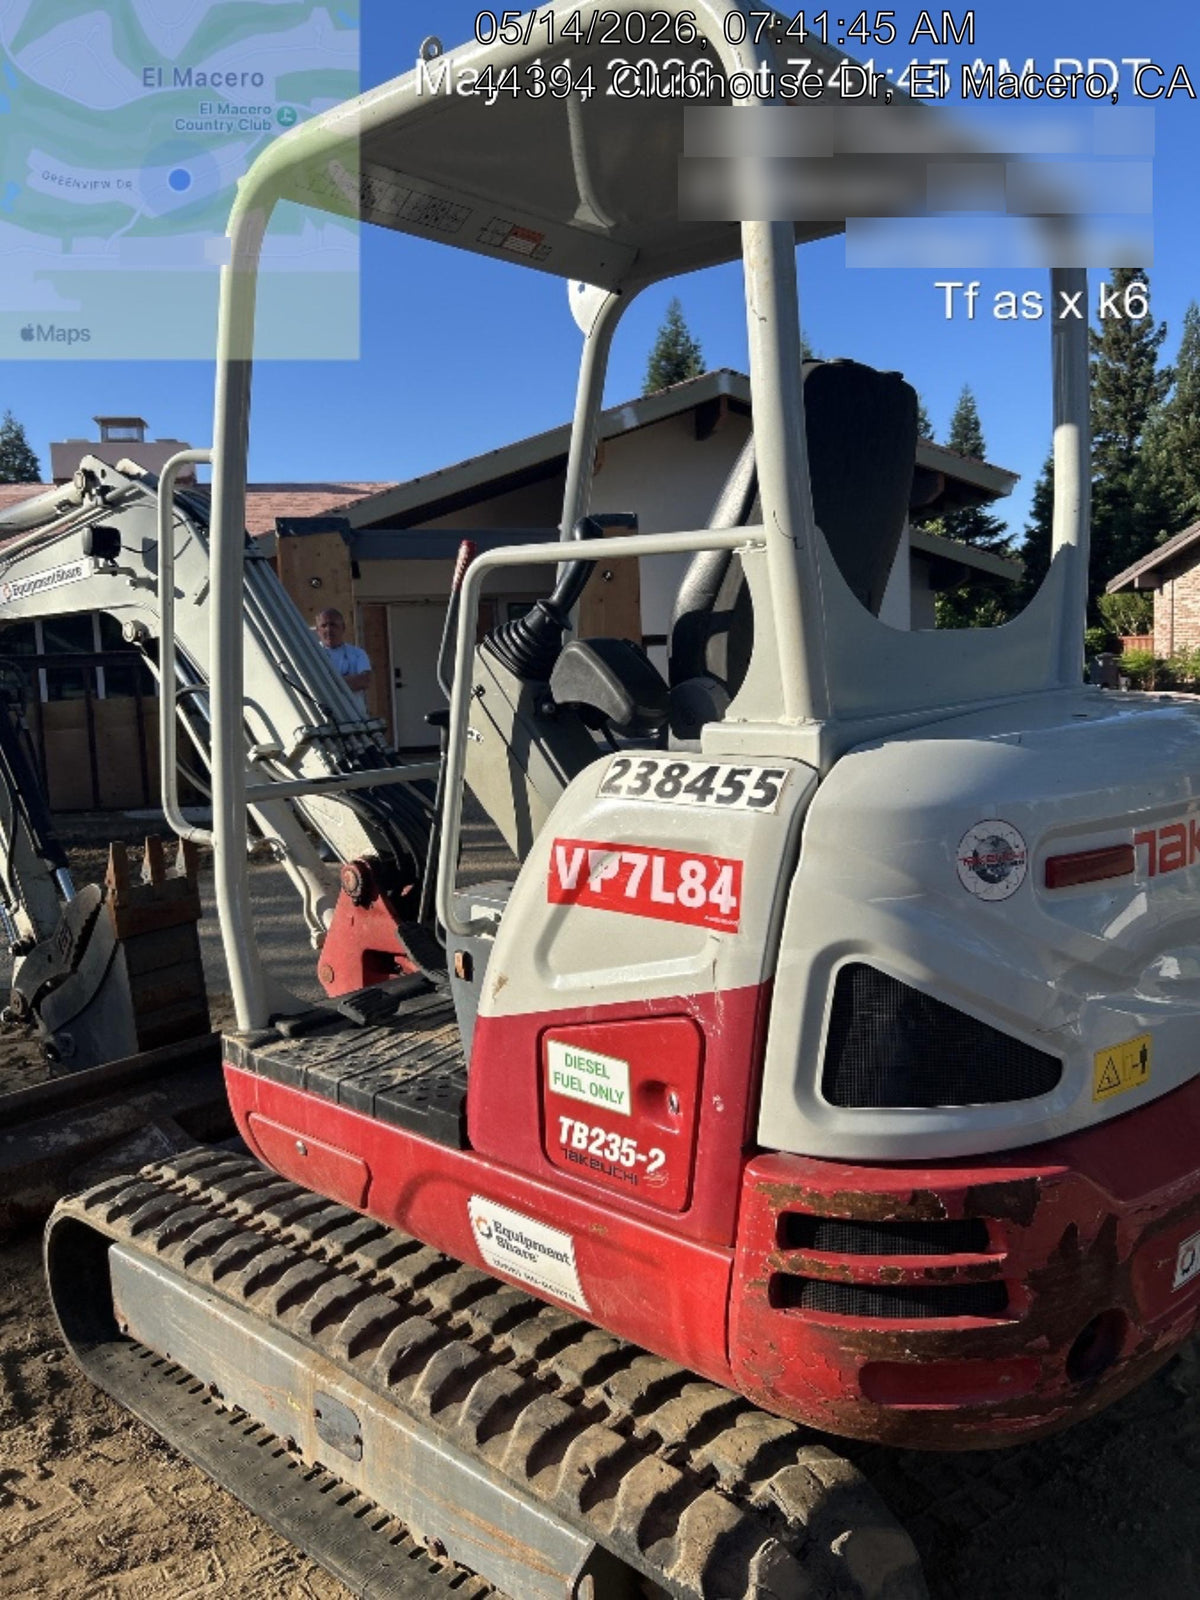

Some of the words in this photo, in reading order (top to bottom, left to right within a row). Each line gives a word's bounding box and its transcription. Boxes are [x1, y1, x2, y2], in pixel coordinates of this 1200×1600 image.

[600, 758, 784, 808] 238455
[556, 845, 737, 915] VP7L84
[554, 1071, 586, 1095] FUEL
[589, 1081, 625, 1105] ONLY
[565, 1052, 610, 1080] DIESEL
[558, 1116, 666, 1174] TB235-2
[493, 1219, 572, 1267] Equipment
[495, 1235, 538, 1263] Share
